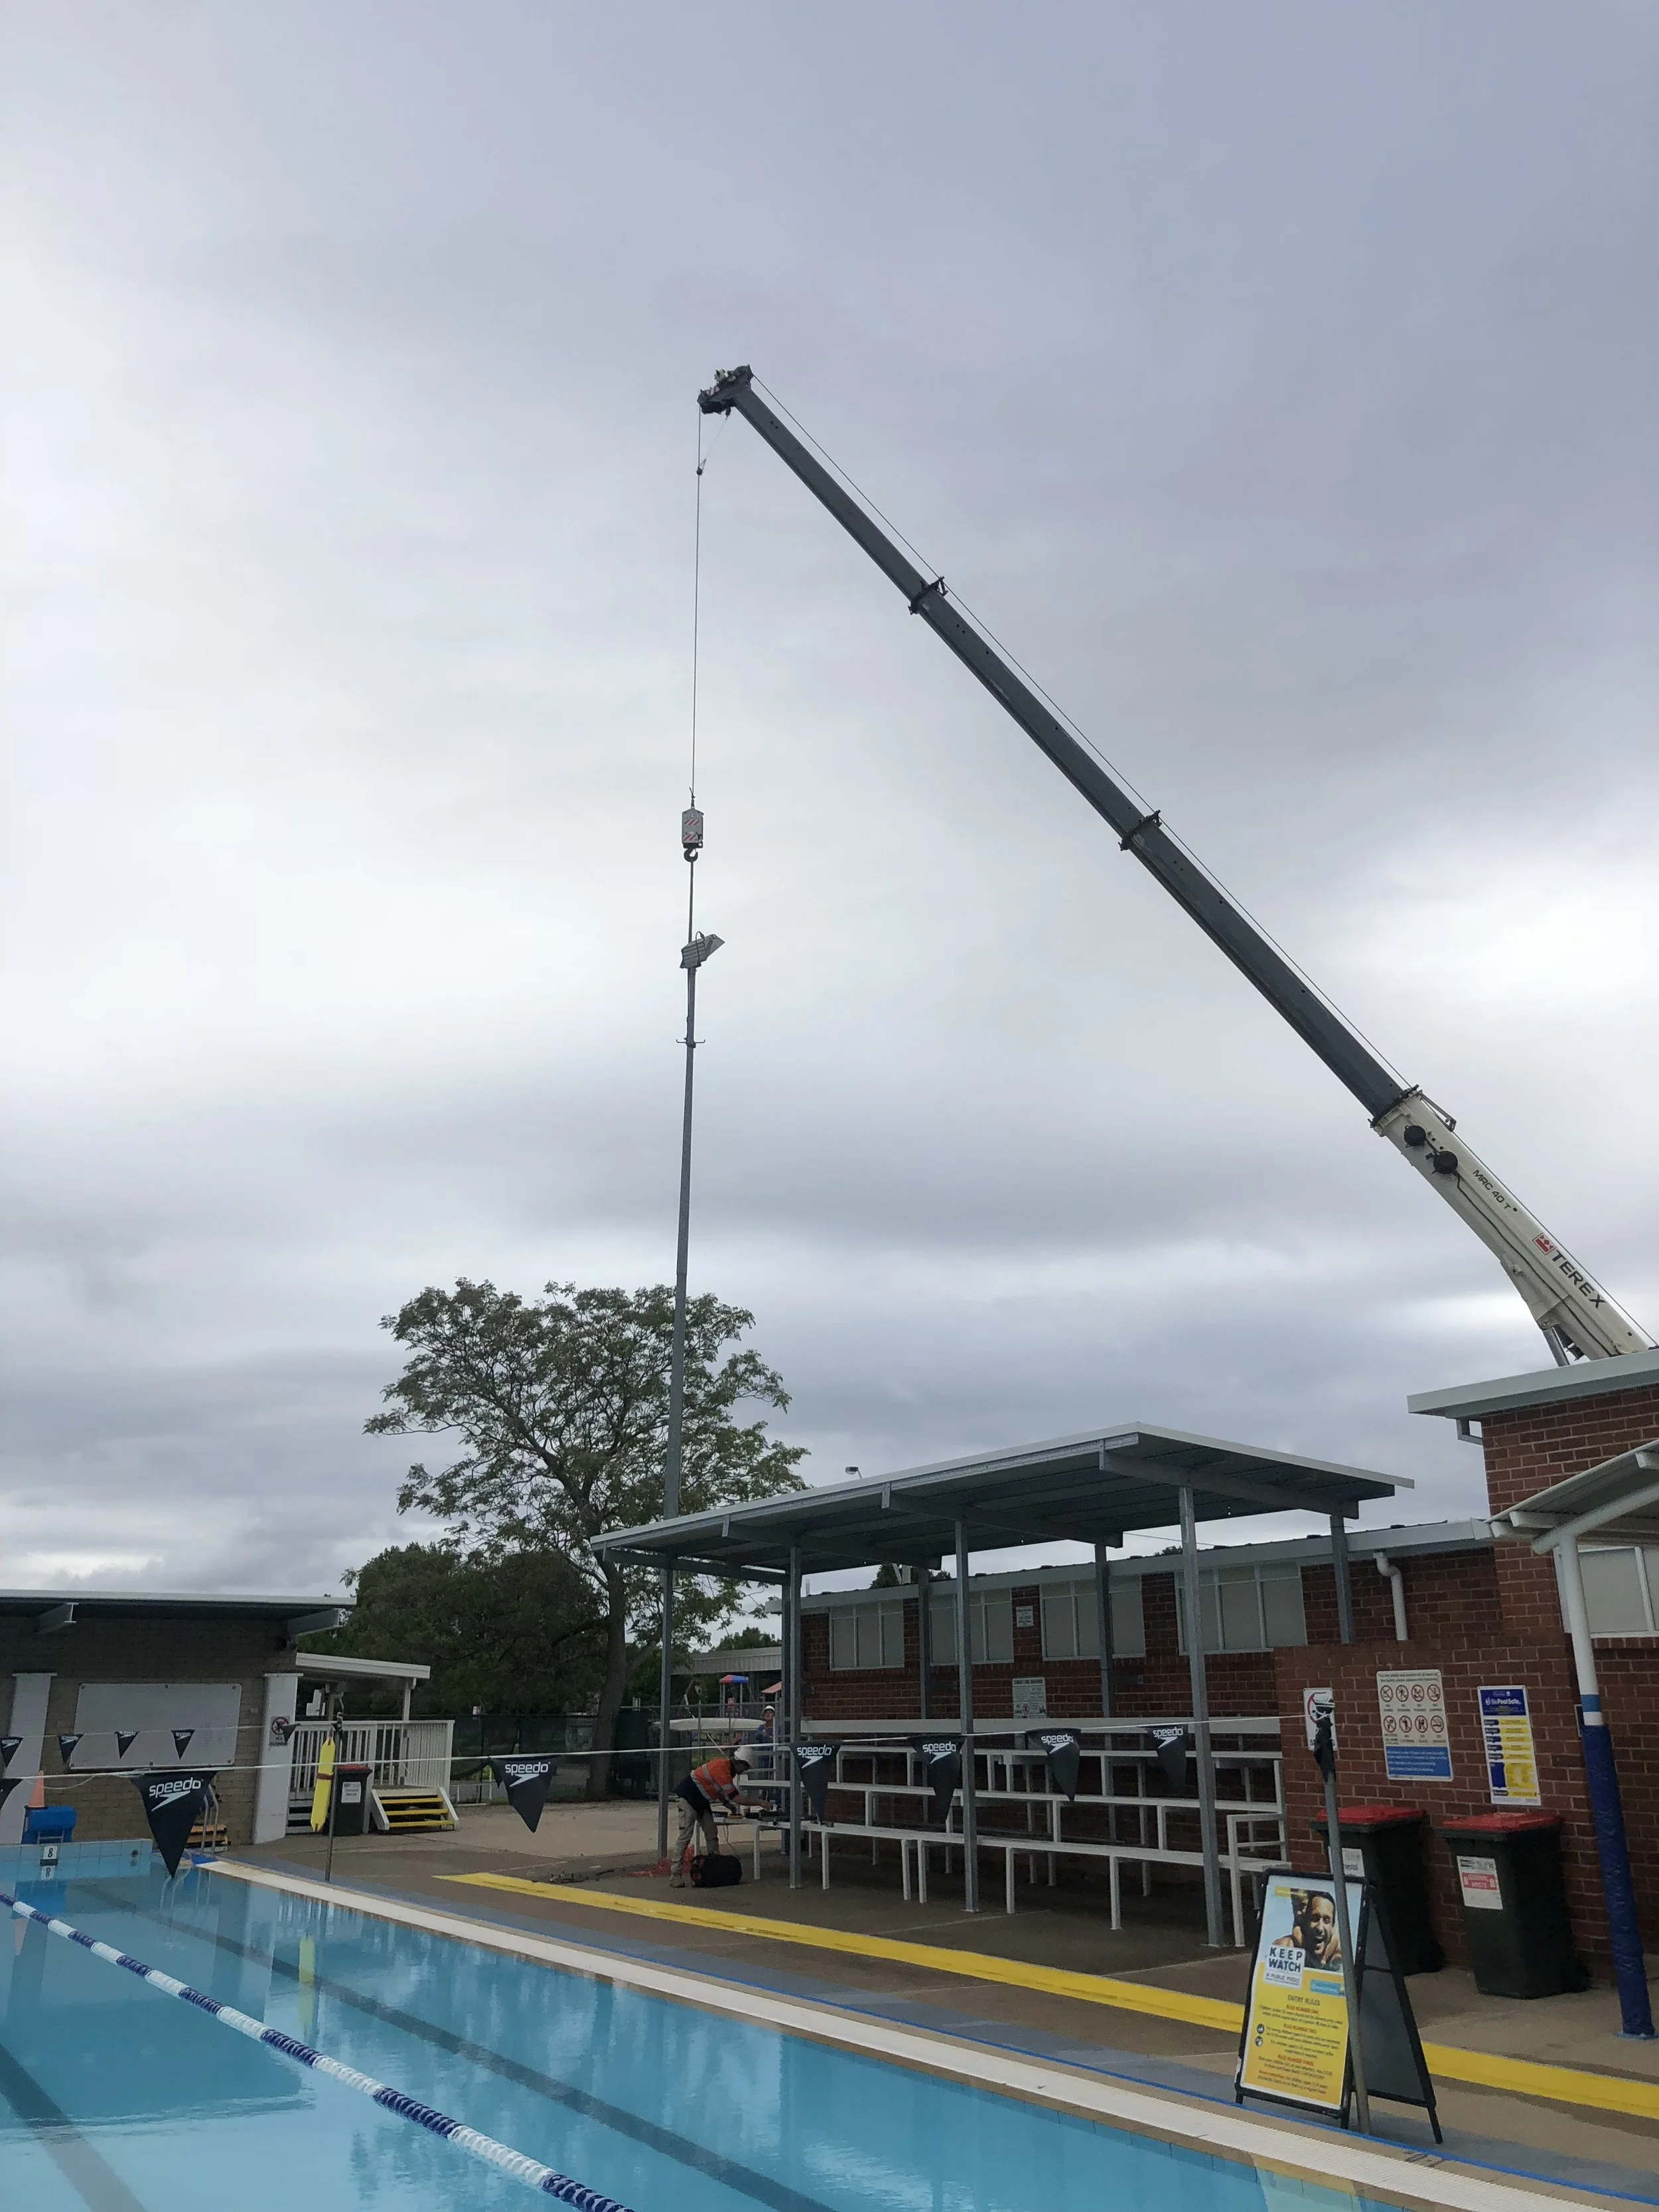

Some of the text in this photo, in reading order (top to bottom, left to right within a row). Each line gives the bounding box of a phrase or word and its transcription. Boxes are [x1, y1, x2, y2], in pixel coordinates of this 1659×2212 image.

[1473, 1169, 1493, 1190] MRC
[1492, 1191, 1504, 1203] 40
[1551, 1249, 1606, 1309] TEREX
[1041, 1733, 1074, 1745] speedo
[1153, 1726, 1183, 1739] speedo
[796, 1744, 832, 1758] speedo
[922, 1741, 956, 1754] speedo
[504, 1761, 549, 1776] speedo
[149, 1777, 202, 1799] speedo
[48, 1847, 54, 1858] 8
[1269, 1947, 1303, 1961] KEEP
[1268, 1957, 1301, 1972] WATCH
